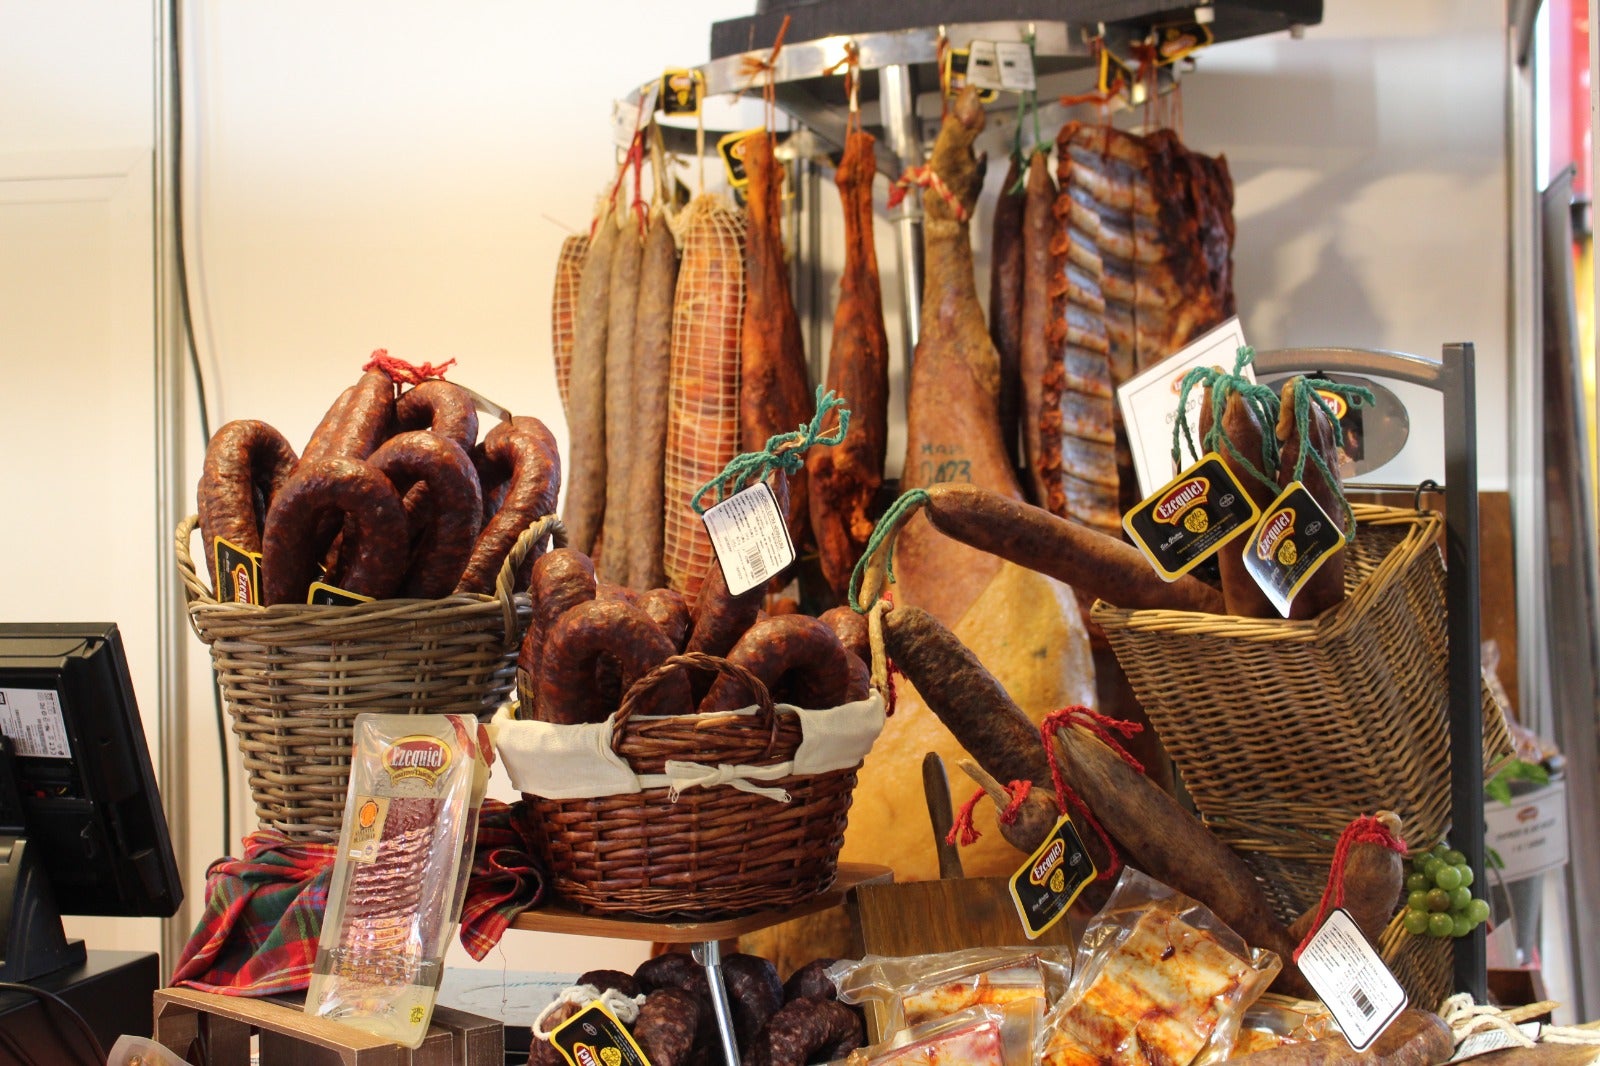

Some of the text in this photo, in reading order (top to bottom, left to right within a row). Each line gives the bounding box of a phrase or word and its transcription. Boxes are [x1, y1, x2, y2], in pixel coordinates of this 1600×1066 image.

[1157, 480, 1204, 519] Ezequiel
[1258, 511, 1291, 555] Ezequiel
[391, 747, 443, 768] Ezequiel
[1034, 842, 1062, 880] Ezequiel
